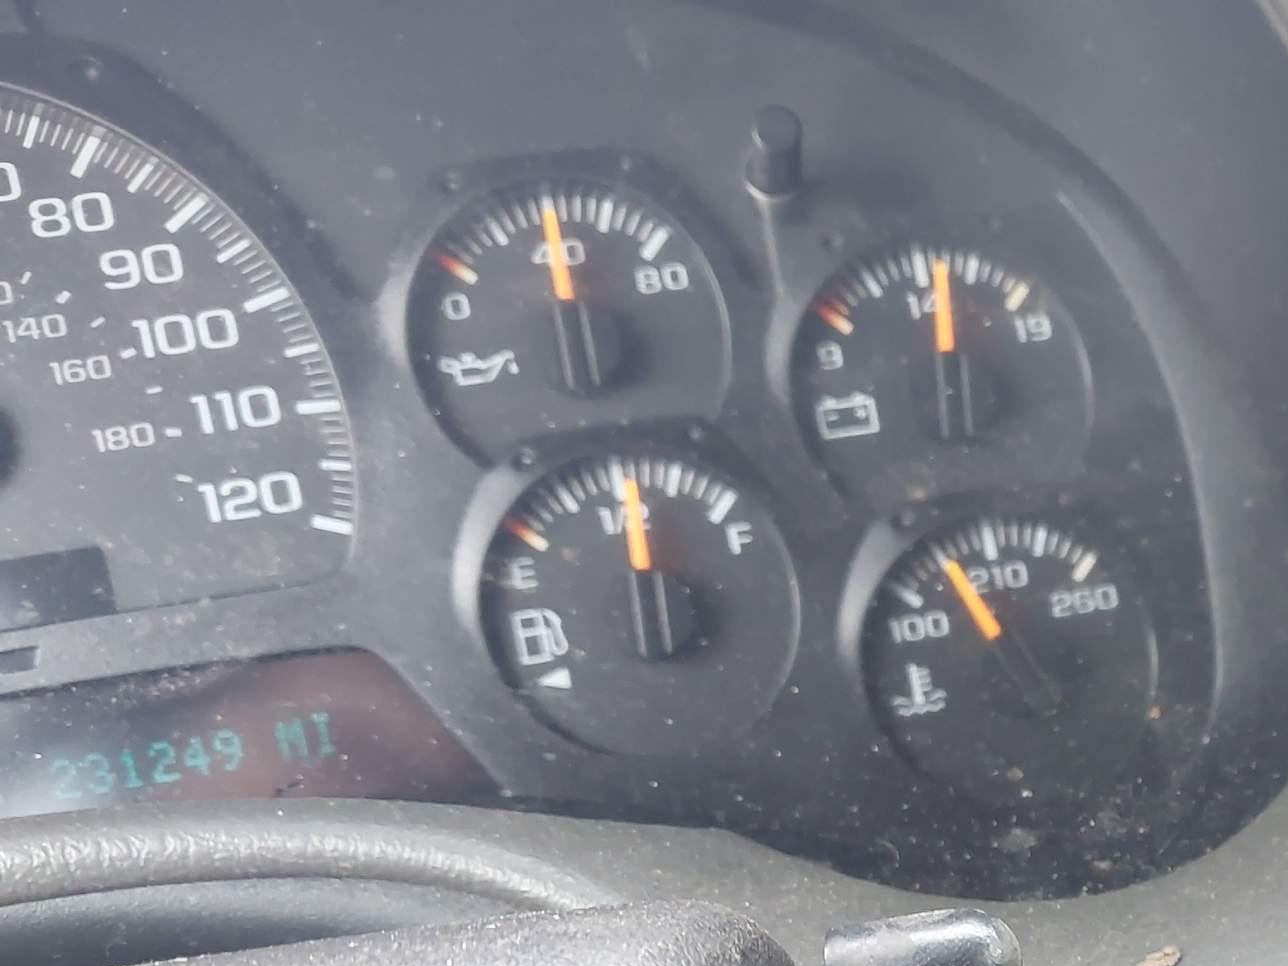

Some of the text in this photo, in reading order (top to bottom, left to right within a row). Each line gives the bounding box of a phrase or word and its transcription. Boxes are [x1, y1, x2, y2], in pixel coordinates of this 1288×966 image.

[28, 191, 115, 238] 80
[100, 243, 184, 290] 90
[634, 261, 690, 295] 80
[441, 291, 471, 321] 0
[2, 313, 68, 344] 140
[132, 307, 240, 359] 100
[1013, 313, 1053, 344] 19
[49, 354, 113, 385] 160
[816, 340, 844, 371] 9
[189, 384, 282, 435] 110
[91, 421, 155, 453] 180
[197, 471, 303, 524] 120
[725, 521, 753, 555] F
[510, 556, 539, 591] E
[967, 560, 1029, 594] 210
[1049, 582, 1119, 618] 260
[889, 610, 951, 644] 100
[49, 711, 337, 799] 231249 MI
